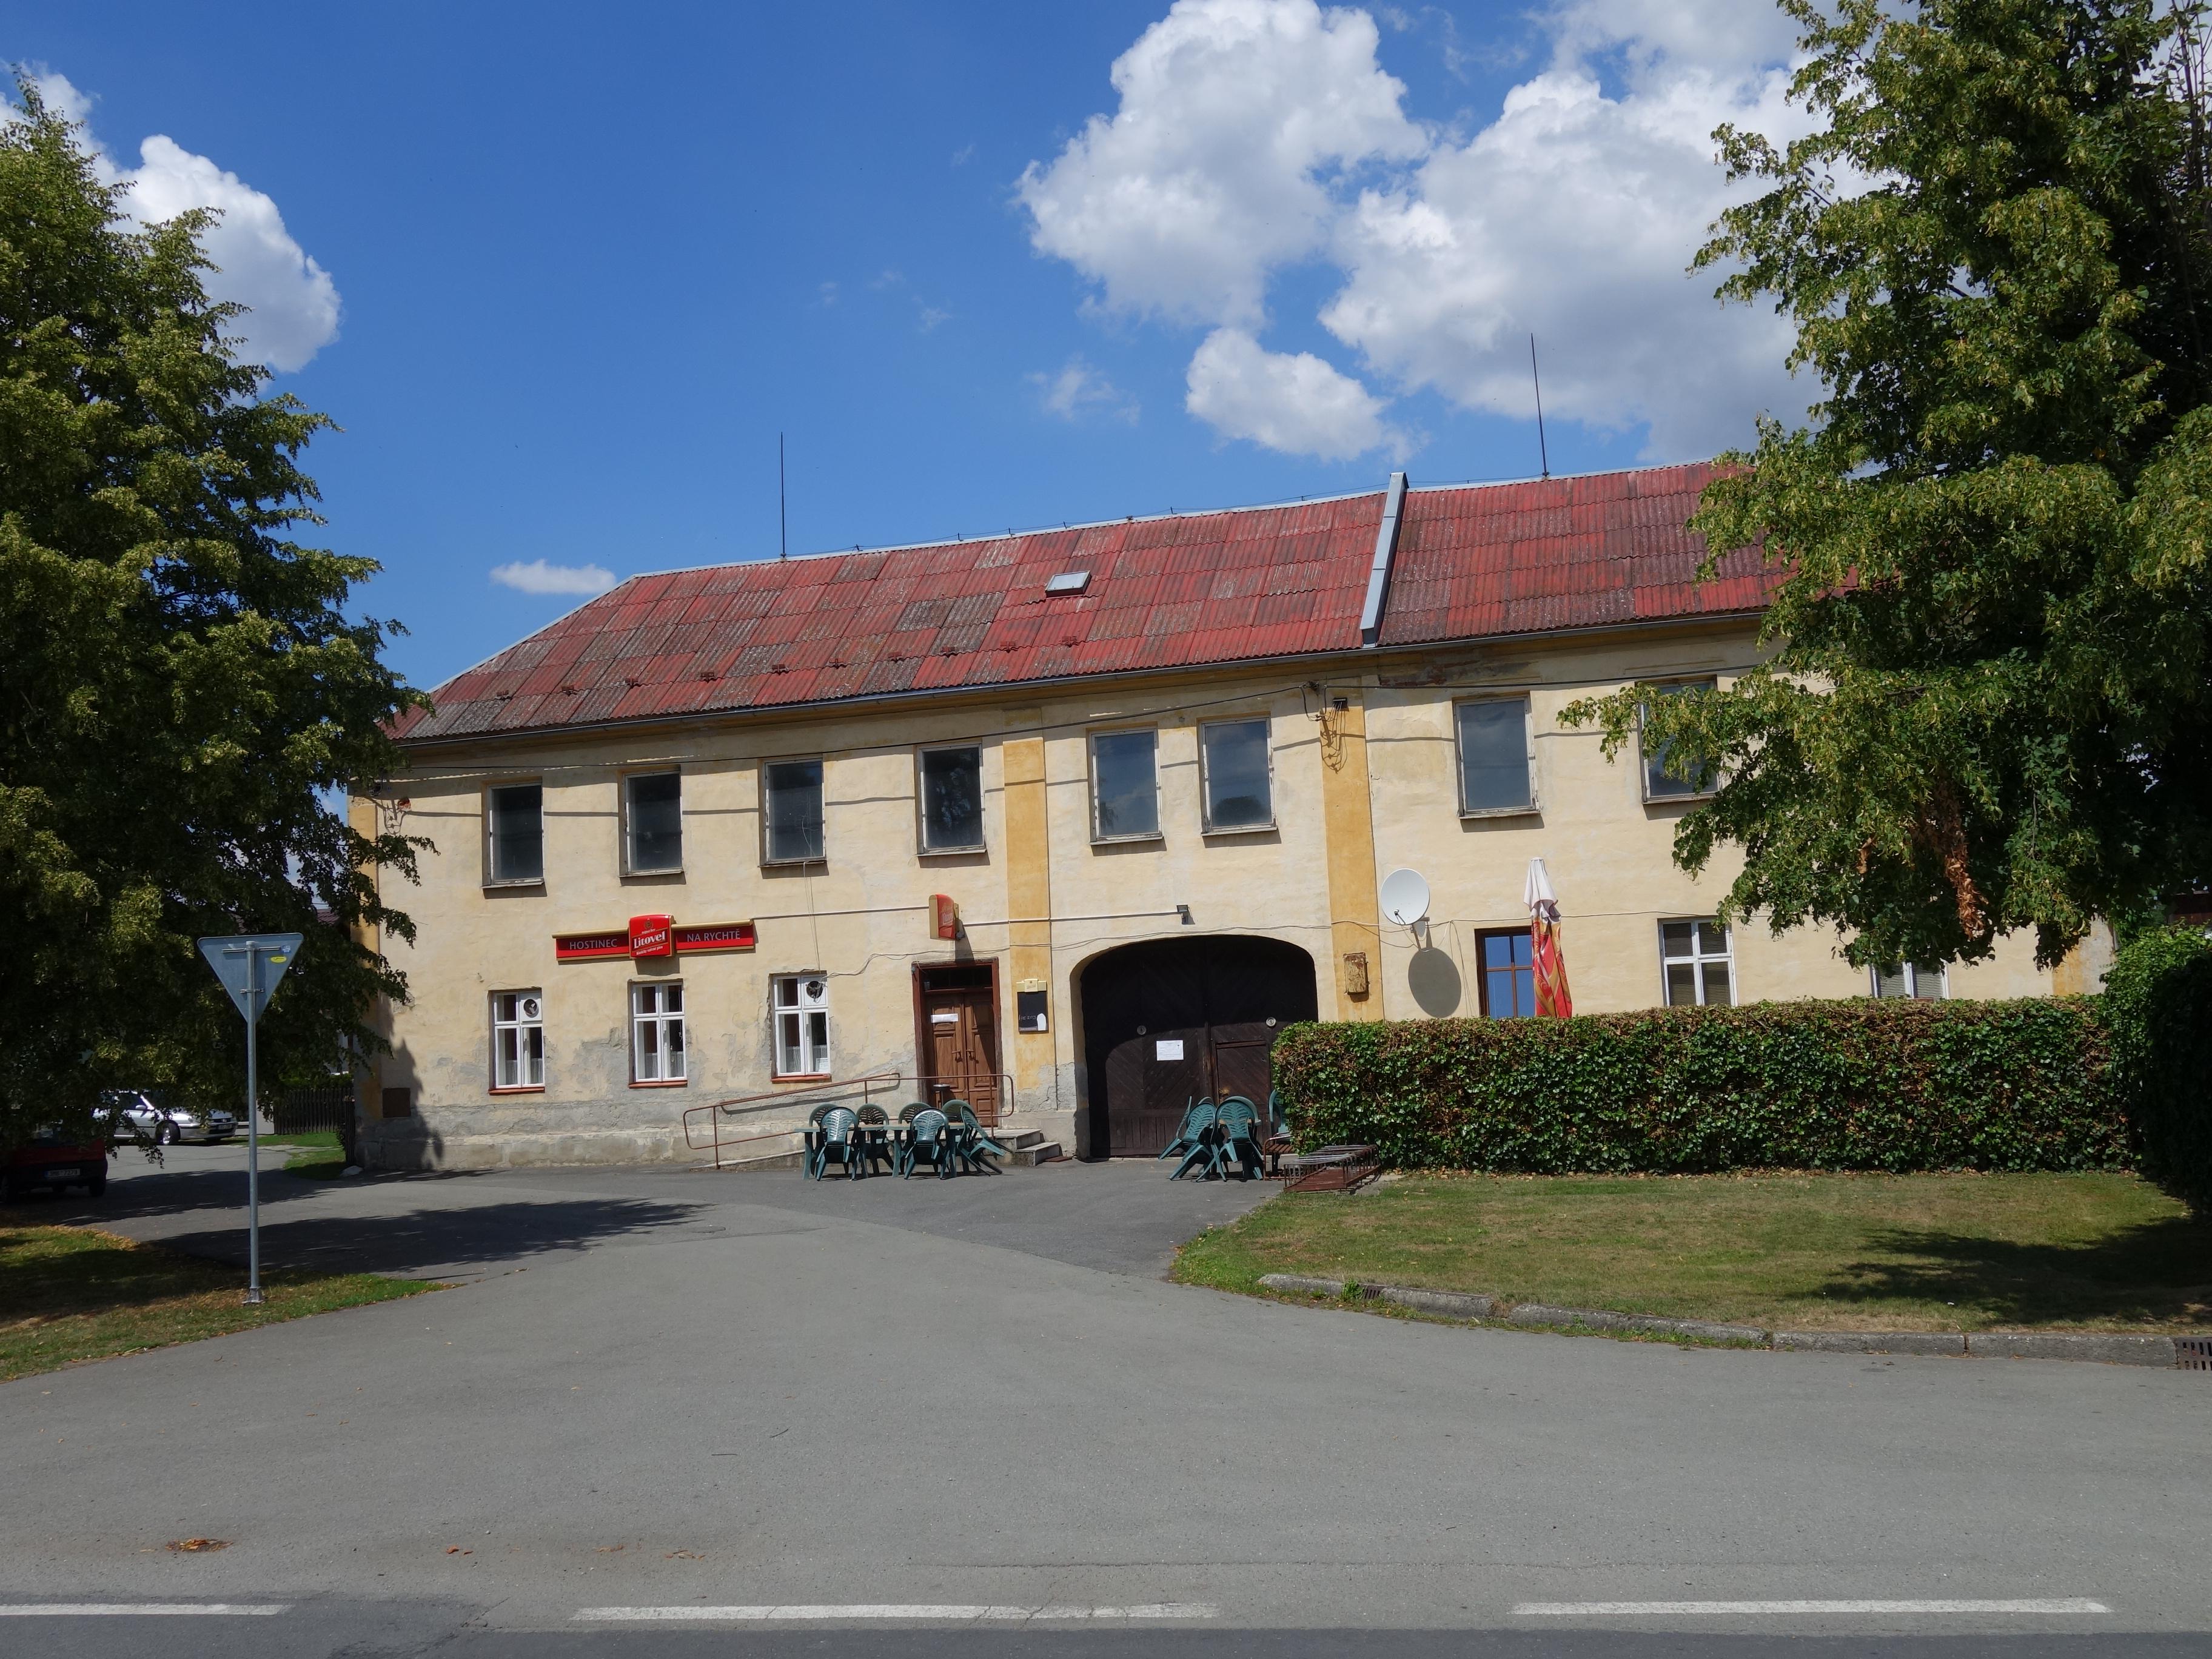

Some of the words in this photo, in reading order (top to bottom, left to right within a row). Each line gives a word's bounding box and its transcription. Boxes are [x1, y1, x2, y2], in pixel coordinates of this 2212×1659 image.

[634, 931, 665, 949] Litovel
[687, 933, 701, 942] NA
[703, 928, 740, 941] RYCHTĚ
[569, 939, 617, 950] HOSTINEC
